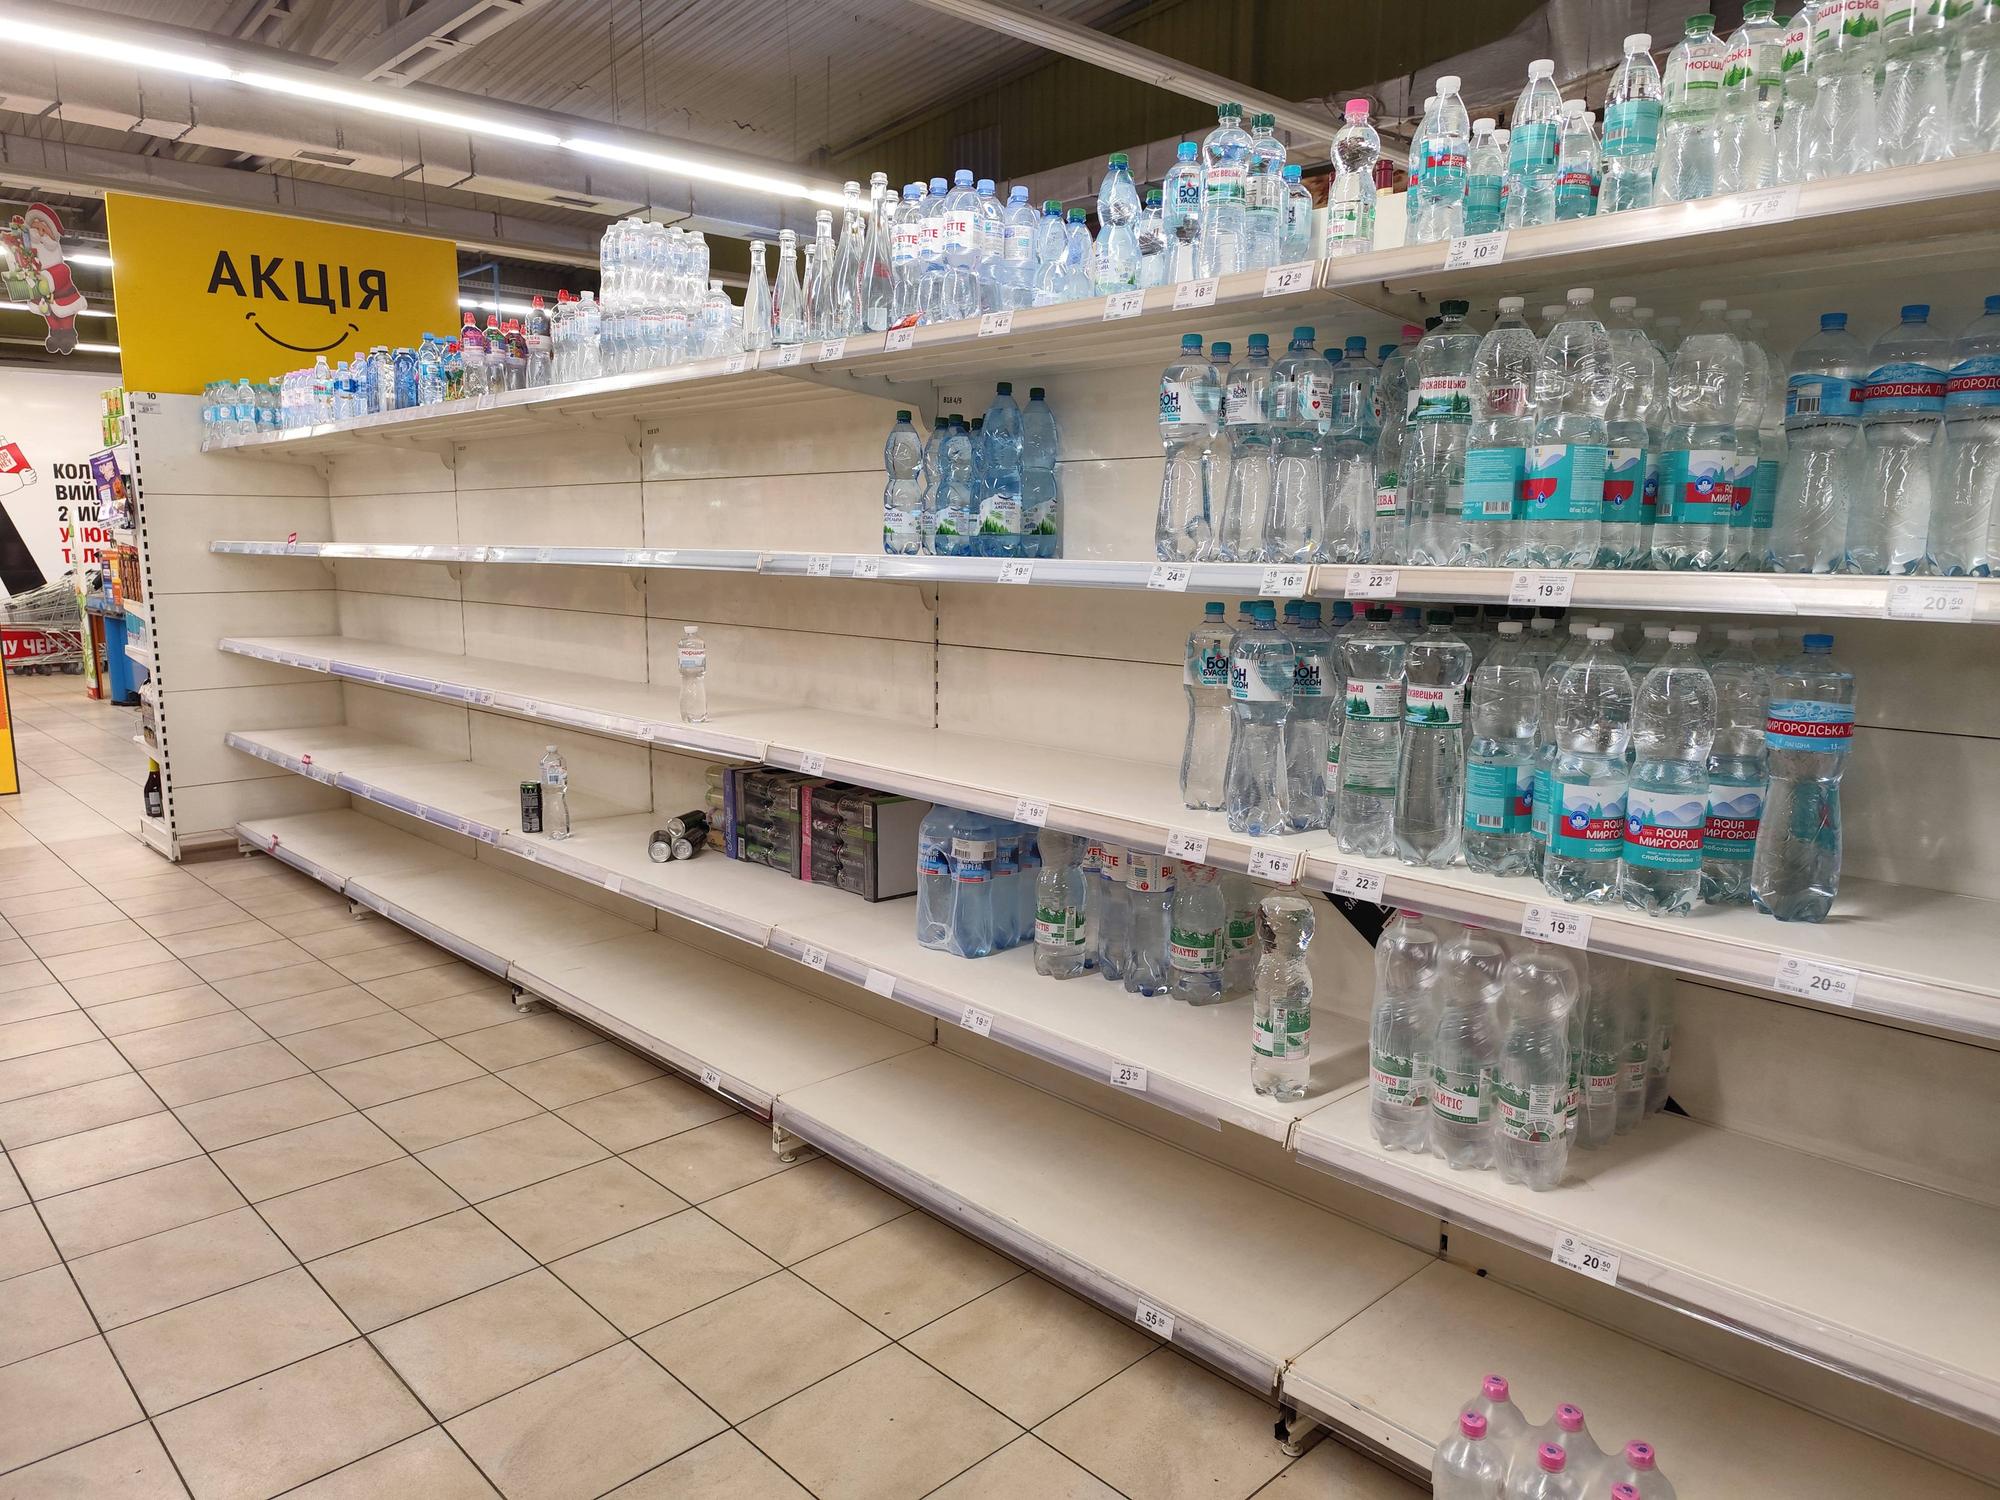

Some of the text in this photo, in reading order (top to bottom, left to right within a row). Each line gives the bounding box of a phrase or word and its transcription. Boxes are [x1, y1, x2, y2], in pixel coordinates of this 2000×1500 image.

[207, 250, 389, 315] АКЦІЯ
[1369, 576, 1382, 587] 22
[1537, 585, 1553, 597] 19
[1923, 597, 1947, 610] 20
[1713, 818, 1744, 829] AQUA
[1656, 828, 1688, 838] AQUA
[1639, 836, 1698, 849] МИРГОРОД
[1269, 859, 1280, 870] 16
[1355, 877, 1369, 889] 22
[1550, 921, 1565, 933] 19
[1810, 975, 1831, 991] 20
[1120, 1069, 1131, 1080] 23
[1583, 1254, 1599, 1269] 20
[1145, 1311, 1157, 1325] 55
